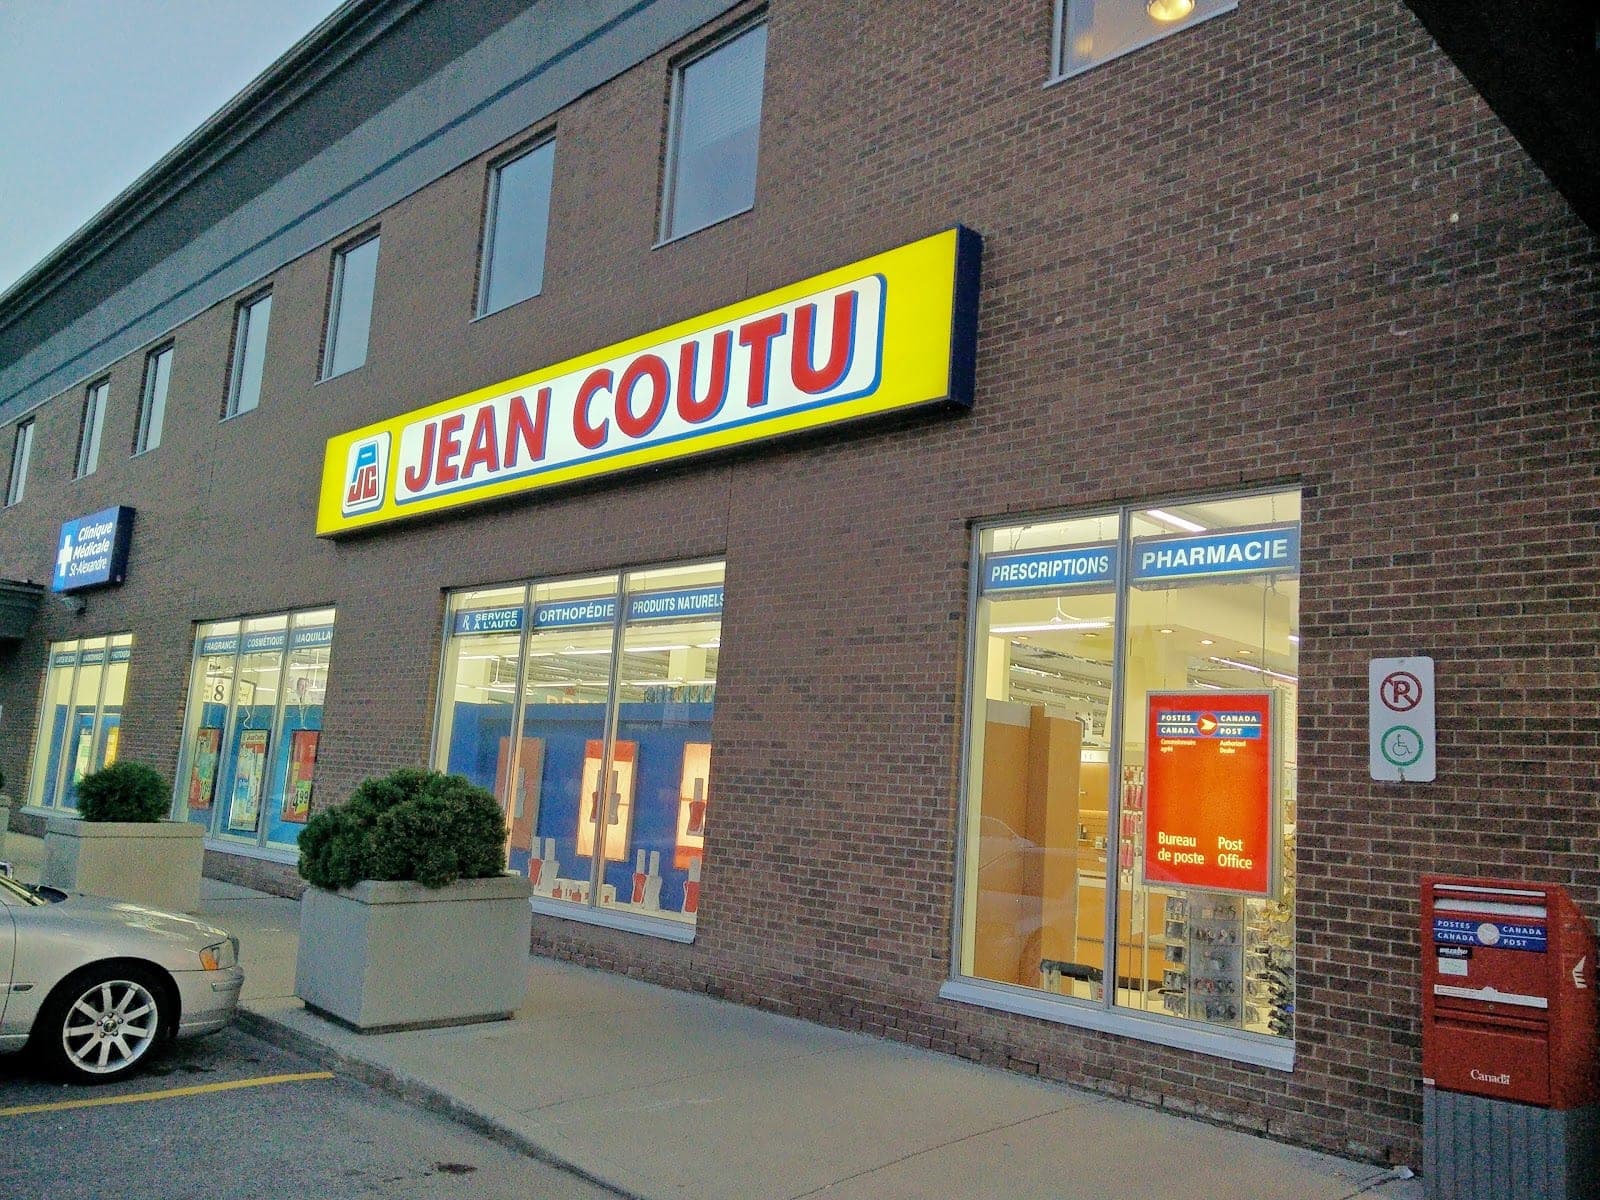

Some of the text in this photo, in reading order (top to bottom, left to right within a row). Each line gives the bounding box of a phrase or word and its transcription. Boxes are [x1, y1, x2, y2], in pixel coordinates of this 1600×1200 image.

[404, 289, 860, 493] JEAN COUTU
[78, 520, 113, 541] Clinique
[73, 538, 110, 560] Médicale
[1142, 538, 1288, 570] PHARMACIE
[68, 556, 107, 577] St-Alexandre
[991, 555, 1109, 582] PRESCRIPTIONS
[632, 592, 724, 613] PRODUITS NATURELS
[475, 610, 518, 620] SERVICE
[539, 602, 615, 622] ORTHOPÉDIE
[483, 619, 518, 629] L'AUTO
[295, 630, 334, 644] MAQUILLA
[204, 640, 236, 651] FRAGRANCE
[213, 684, 225, 702] 8
[1161, 714, 1257, 723] POSTES CANADA
[1161, 727, 1243, 735] CANADA POST
[1158, 832, 1196, 847] Bureau
[1218, 837, 1244, 851] Post
[1157, 850, 1205, 865] de poste
[1218, 854, 1253, 869] Office
[1437, 920, 1542, 936] POSTES CANADA
[1437, 932, 1528, 947] CANADA POST
[1470, 1069, 1510, 1085] Canada
